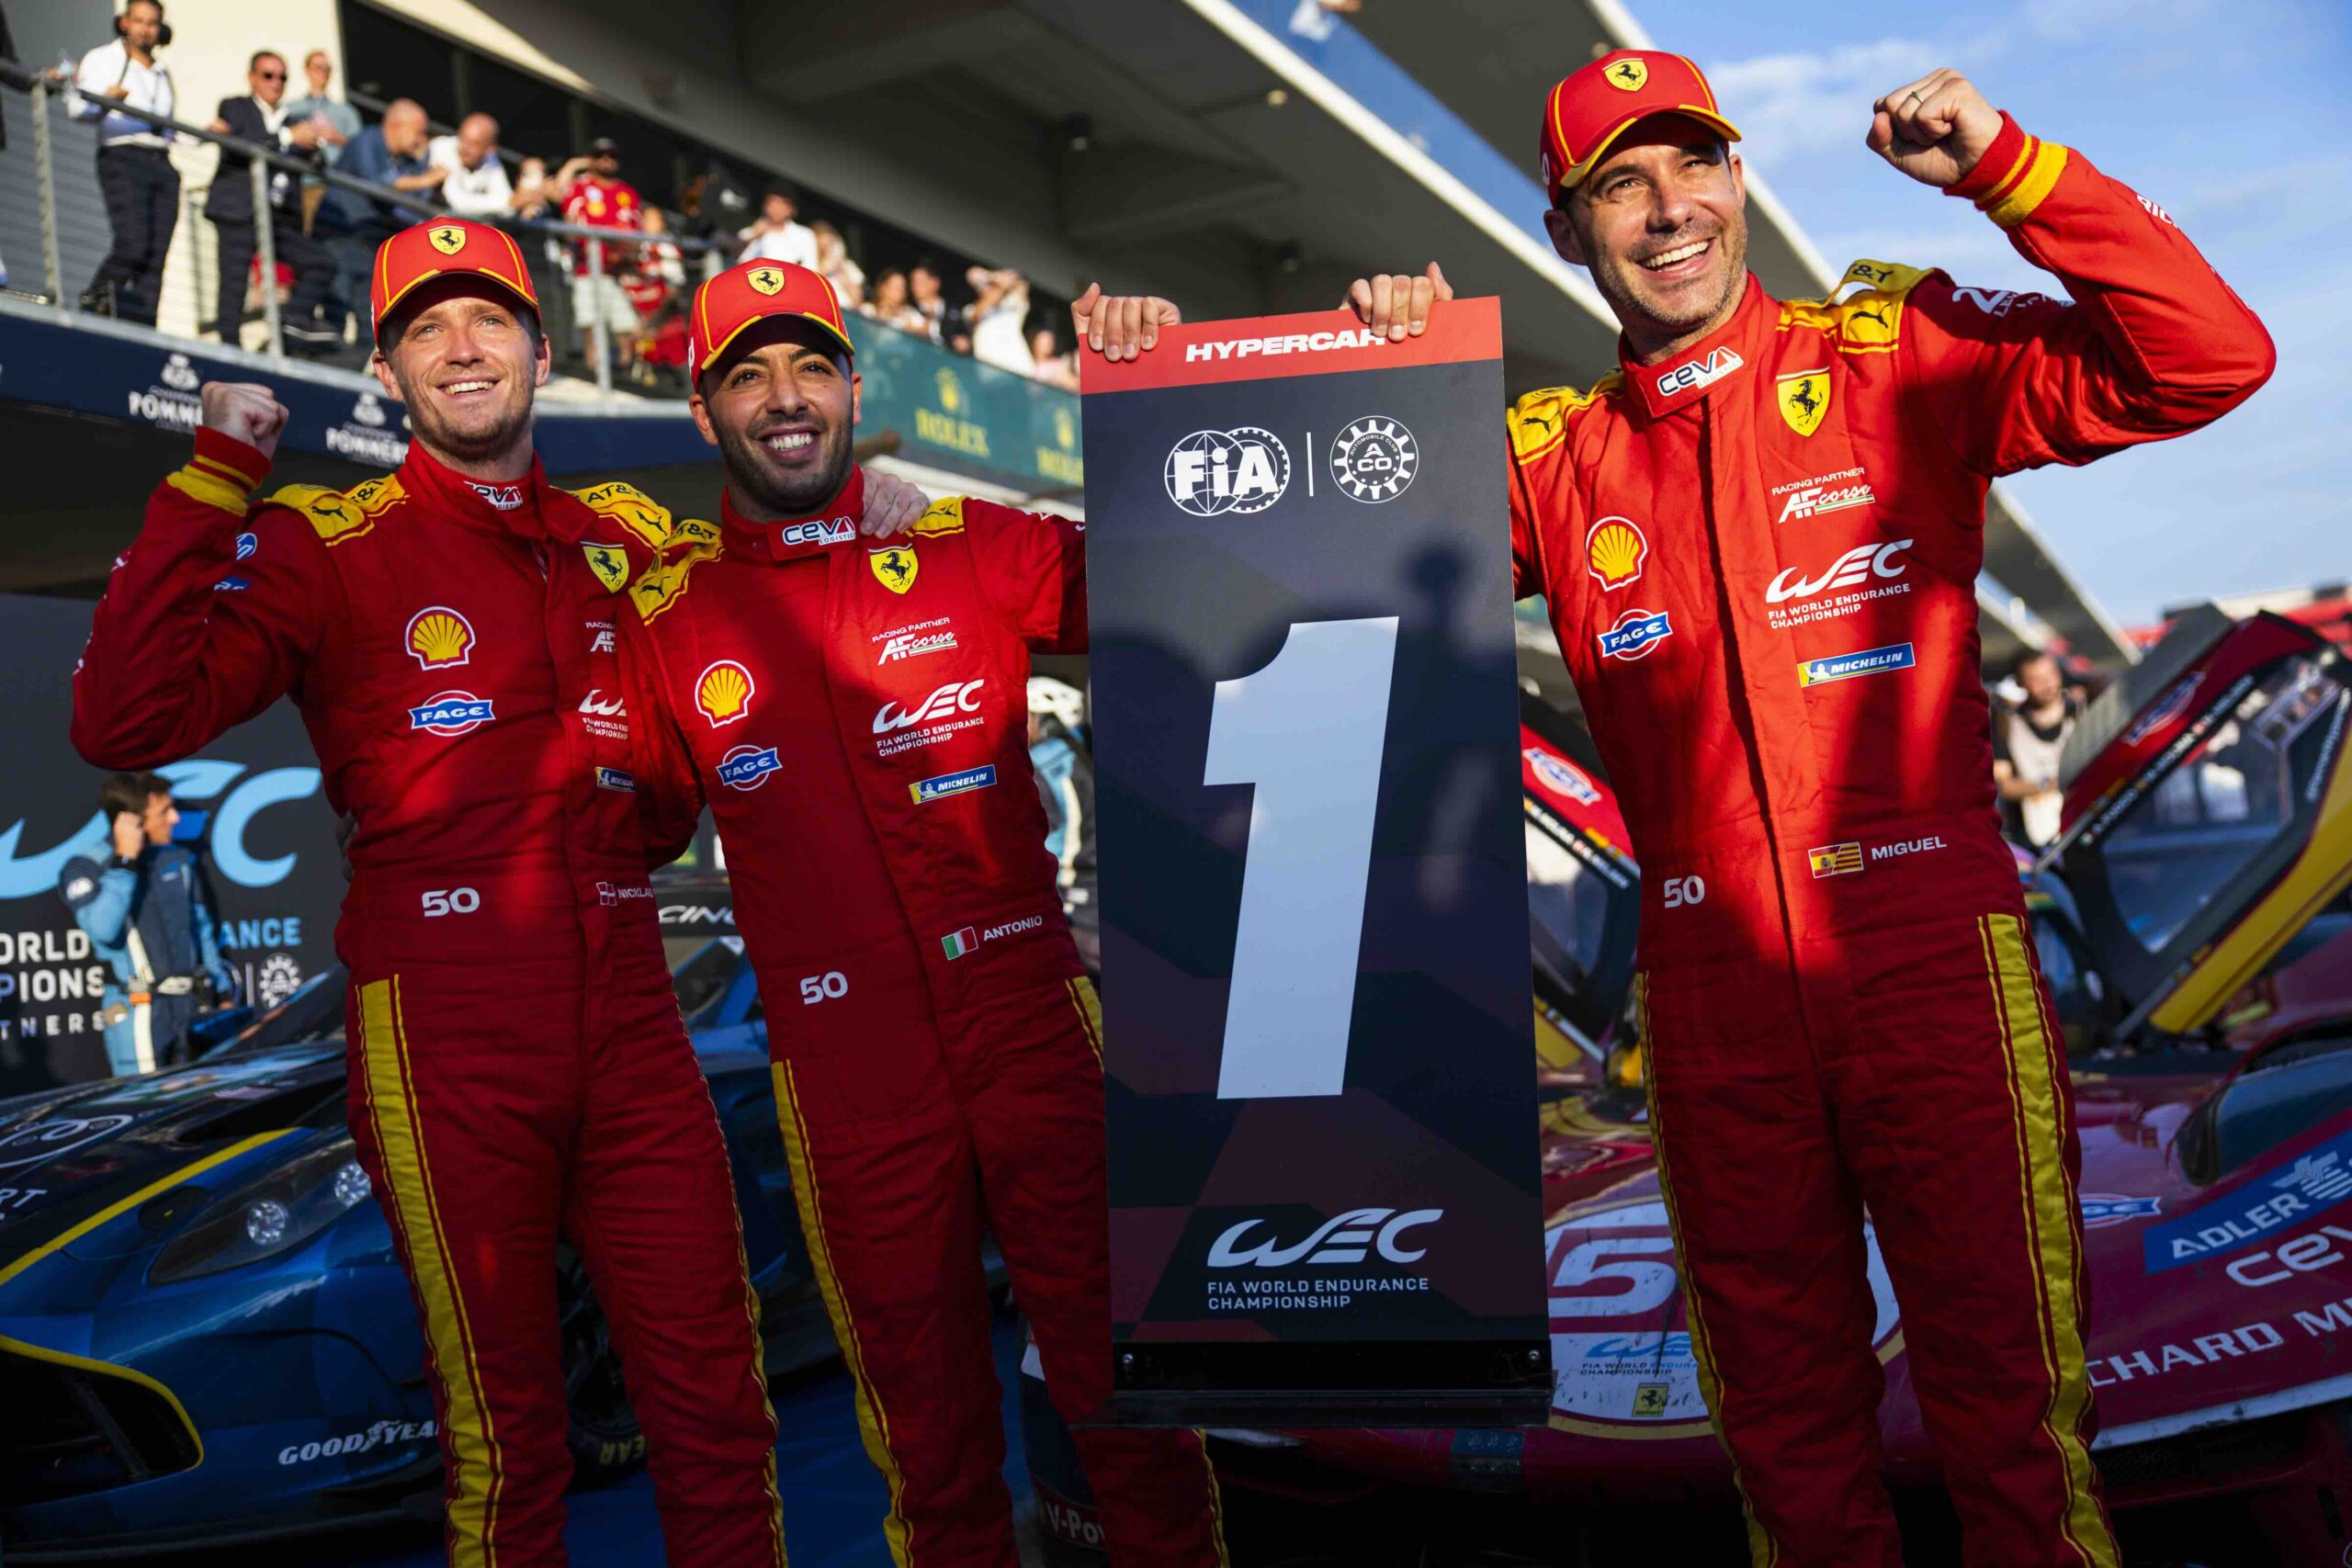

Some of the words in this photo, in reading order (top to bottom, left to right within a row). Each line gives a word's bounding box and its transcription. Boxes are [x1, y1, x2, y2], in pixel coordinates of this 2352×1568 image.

[1350, 434, 1385, 456] AUTOMOBILE
[1385, 437, 1398, 453] CLUB
[1771, 479, 1813, 496] RACING
[1815, 468, 1865, 485] PARTNER
[1766, 538, 1914, 604] WEC
[1768, 610, 1787, 620] FIA
[1789, 599, 1833, 617] WORLD
[1836, 583, 1911, 605] ENDURANCE
[872, 626, 908, 643] RACING
[908, 617, 950, 632] PARTNER
[1770, 604, 1861, 629] CHAMPIONSHIP
[1610, 621, 1663, 649] FAGE
[1830, 652, 1903, 674] MICHELIN
[421, 706, 485, 722] FAGE
[873, 679, 984, 734] WEC
[876, 739, 894, 750] FIA
[894, 728, 931, 746] WORLD
[932, 716, 984, 734] ENDURANCE
[878, 733, 953, 757] CHAMPIONSHIP
[725, 756, 773, 779] FAGE
[937, 773, 988, 792] MICHELIN
[1204, 616, 1399, 1100] 1
[1871, 836, 1948, 861] MIGUEL
[422, 887, 480, 917] 50
[1664, 875, 1705, 908] 50
[983, 915, 1043, 942] ANTONIO
[799, 971, 848, 1005] 50
[1207, 1208, 1443, 1268] WEC
[2172, 1193, 2309, 1259] ADLER
[1207, 1281, 1237, 1294] FIA
[1242, 1280, 1309, 1293] WORLD
[1316, 1278, 1429, 1292] ENDURANCE
[1208, 1295, 1351, 1310] CHAMPIONSHIP
[278, 1420, 439, 1466] GOODYEA
